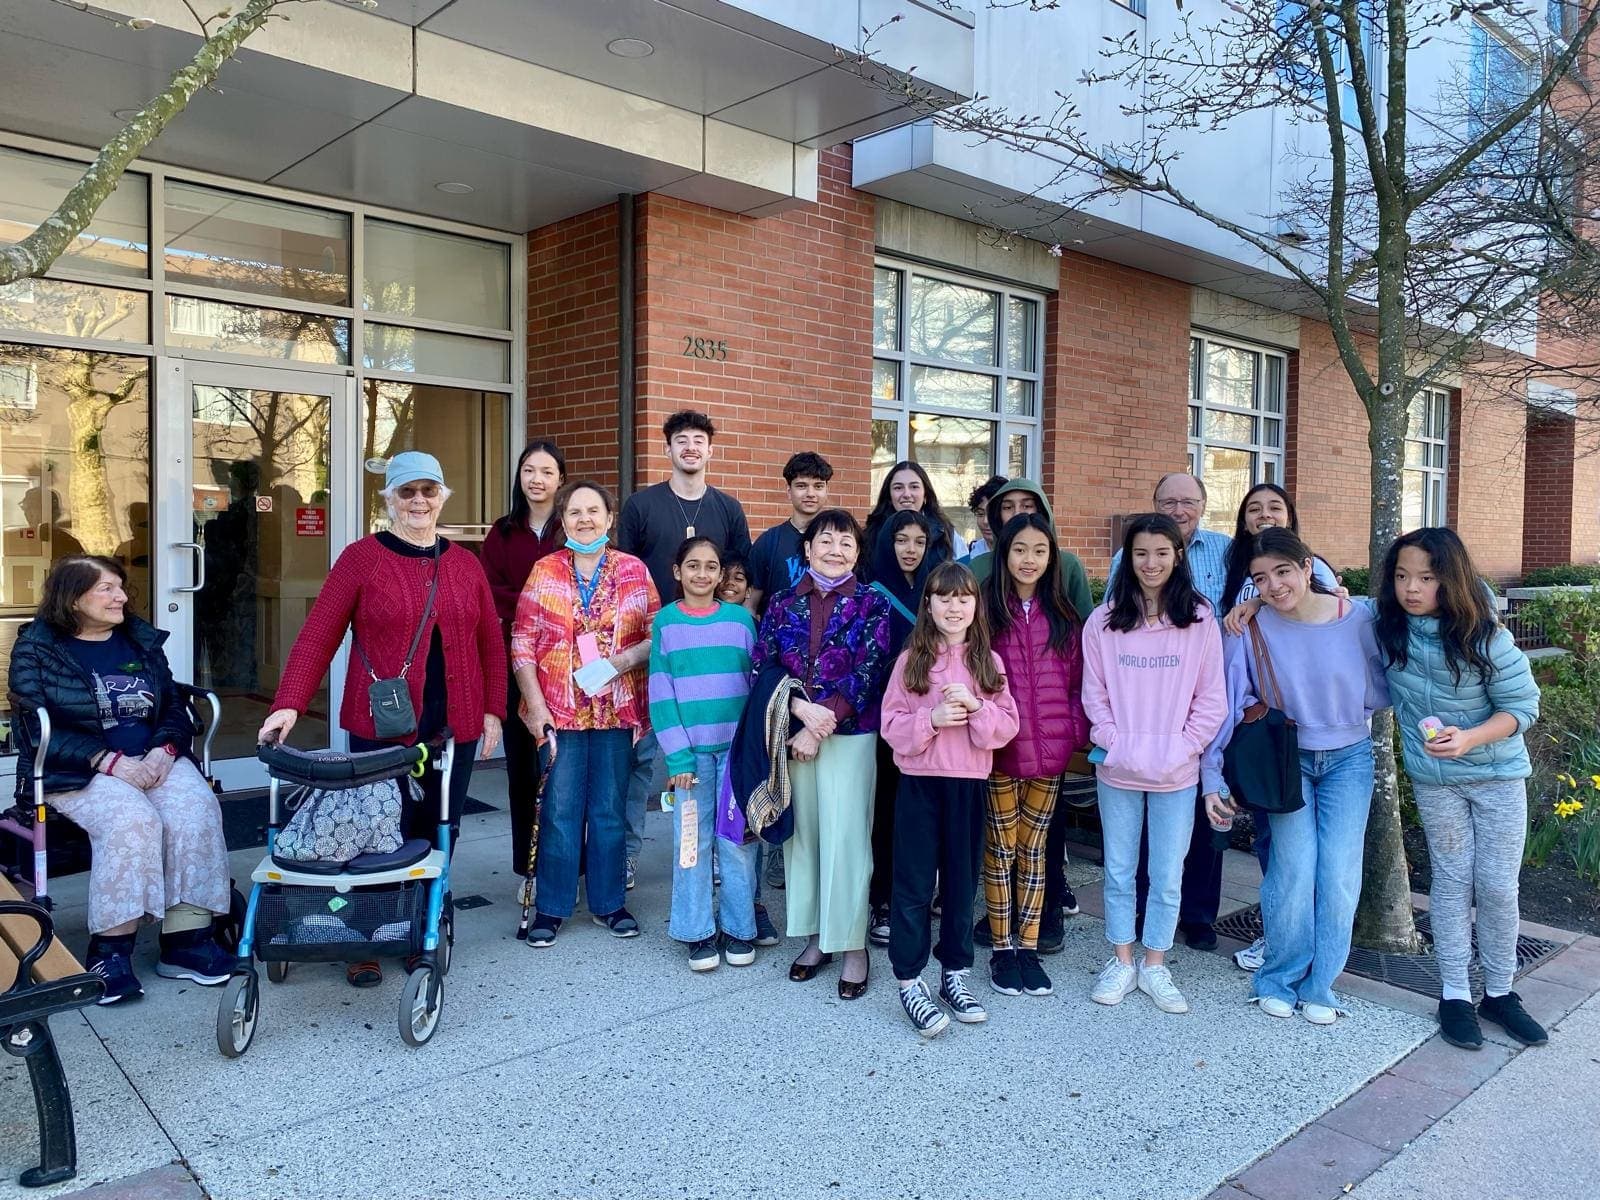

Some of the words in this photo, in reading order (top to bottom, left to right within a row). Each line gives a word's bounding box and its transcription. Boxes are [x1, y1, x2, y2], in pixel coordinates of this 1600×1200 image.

[683, 334, 727, 361] 2835
[1118, 654, 1147, 669] WORLD
[1149, 655, 1180, 669] CITIZEN
